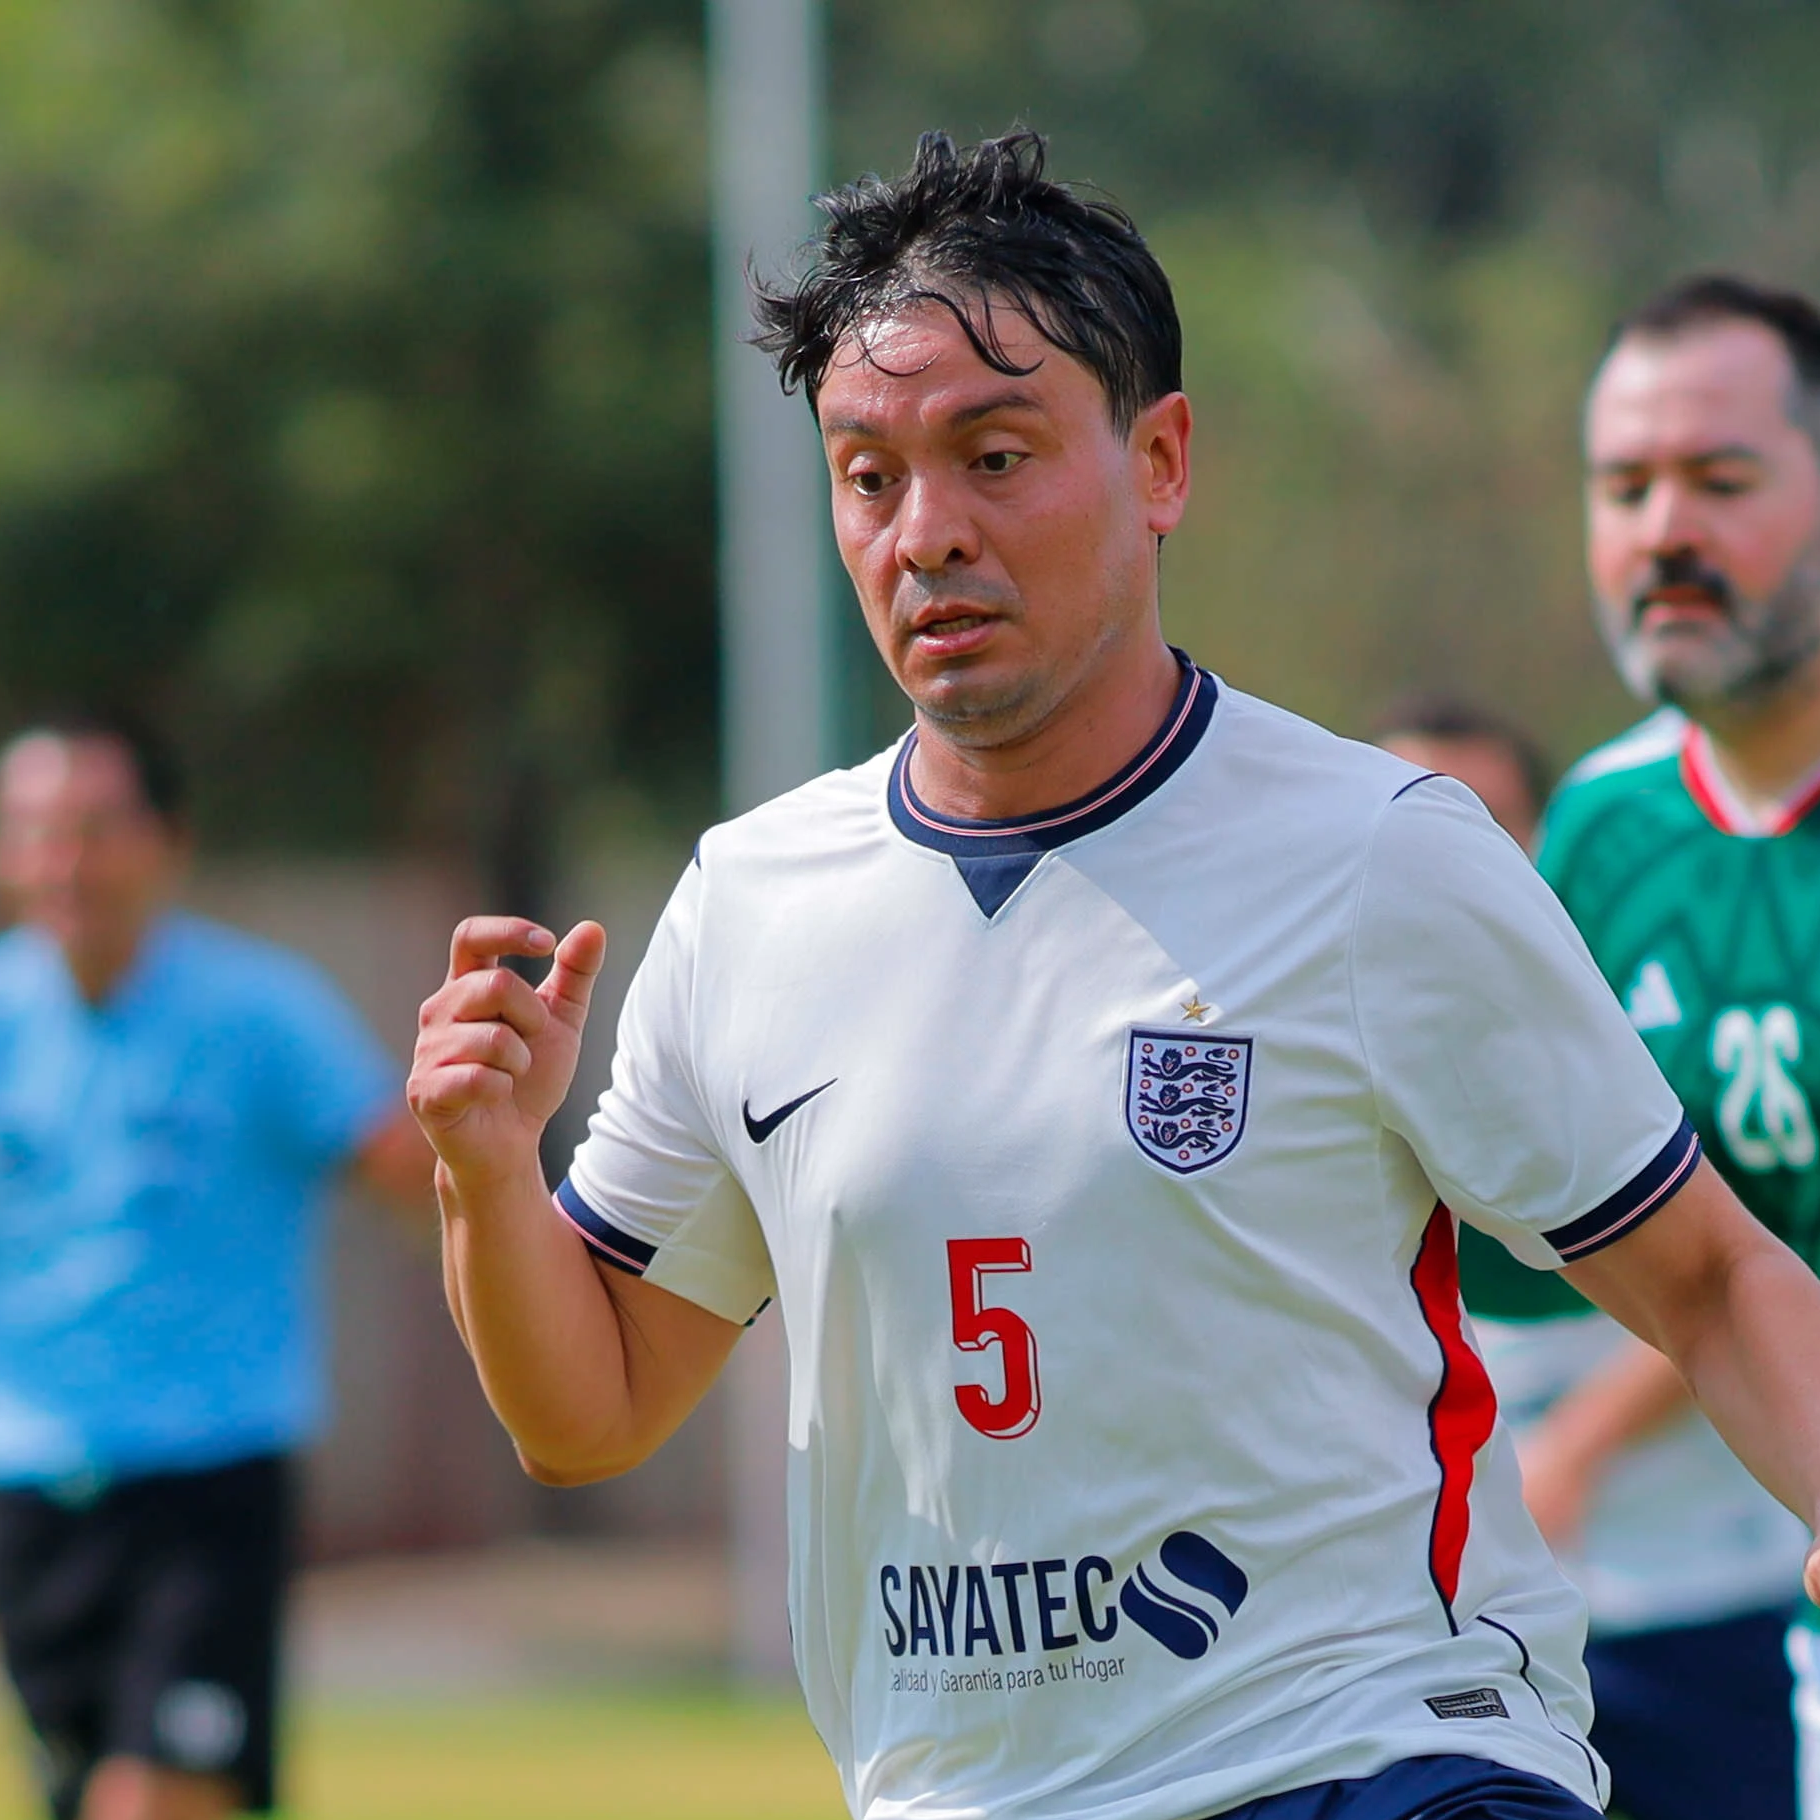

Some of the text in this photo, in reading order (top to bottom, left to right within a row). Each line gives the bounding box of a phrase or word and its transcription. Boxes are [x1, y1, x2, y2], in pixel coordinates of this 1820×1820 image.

[1712, 1004, 1817, 1170] 26
[946, 1237, 1041, 1440] 5
[880, 1555, 1118, 1657] SAYATEC
[889, 1656, 1125, 1697] alidad y Garantía para tu Hogar
